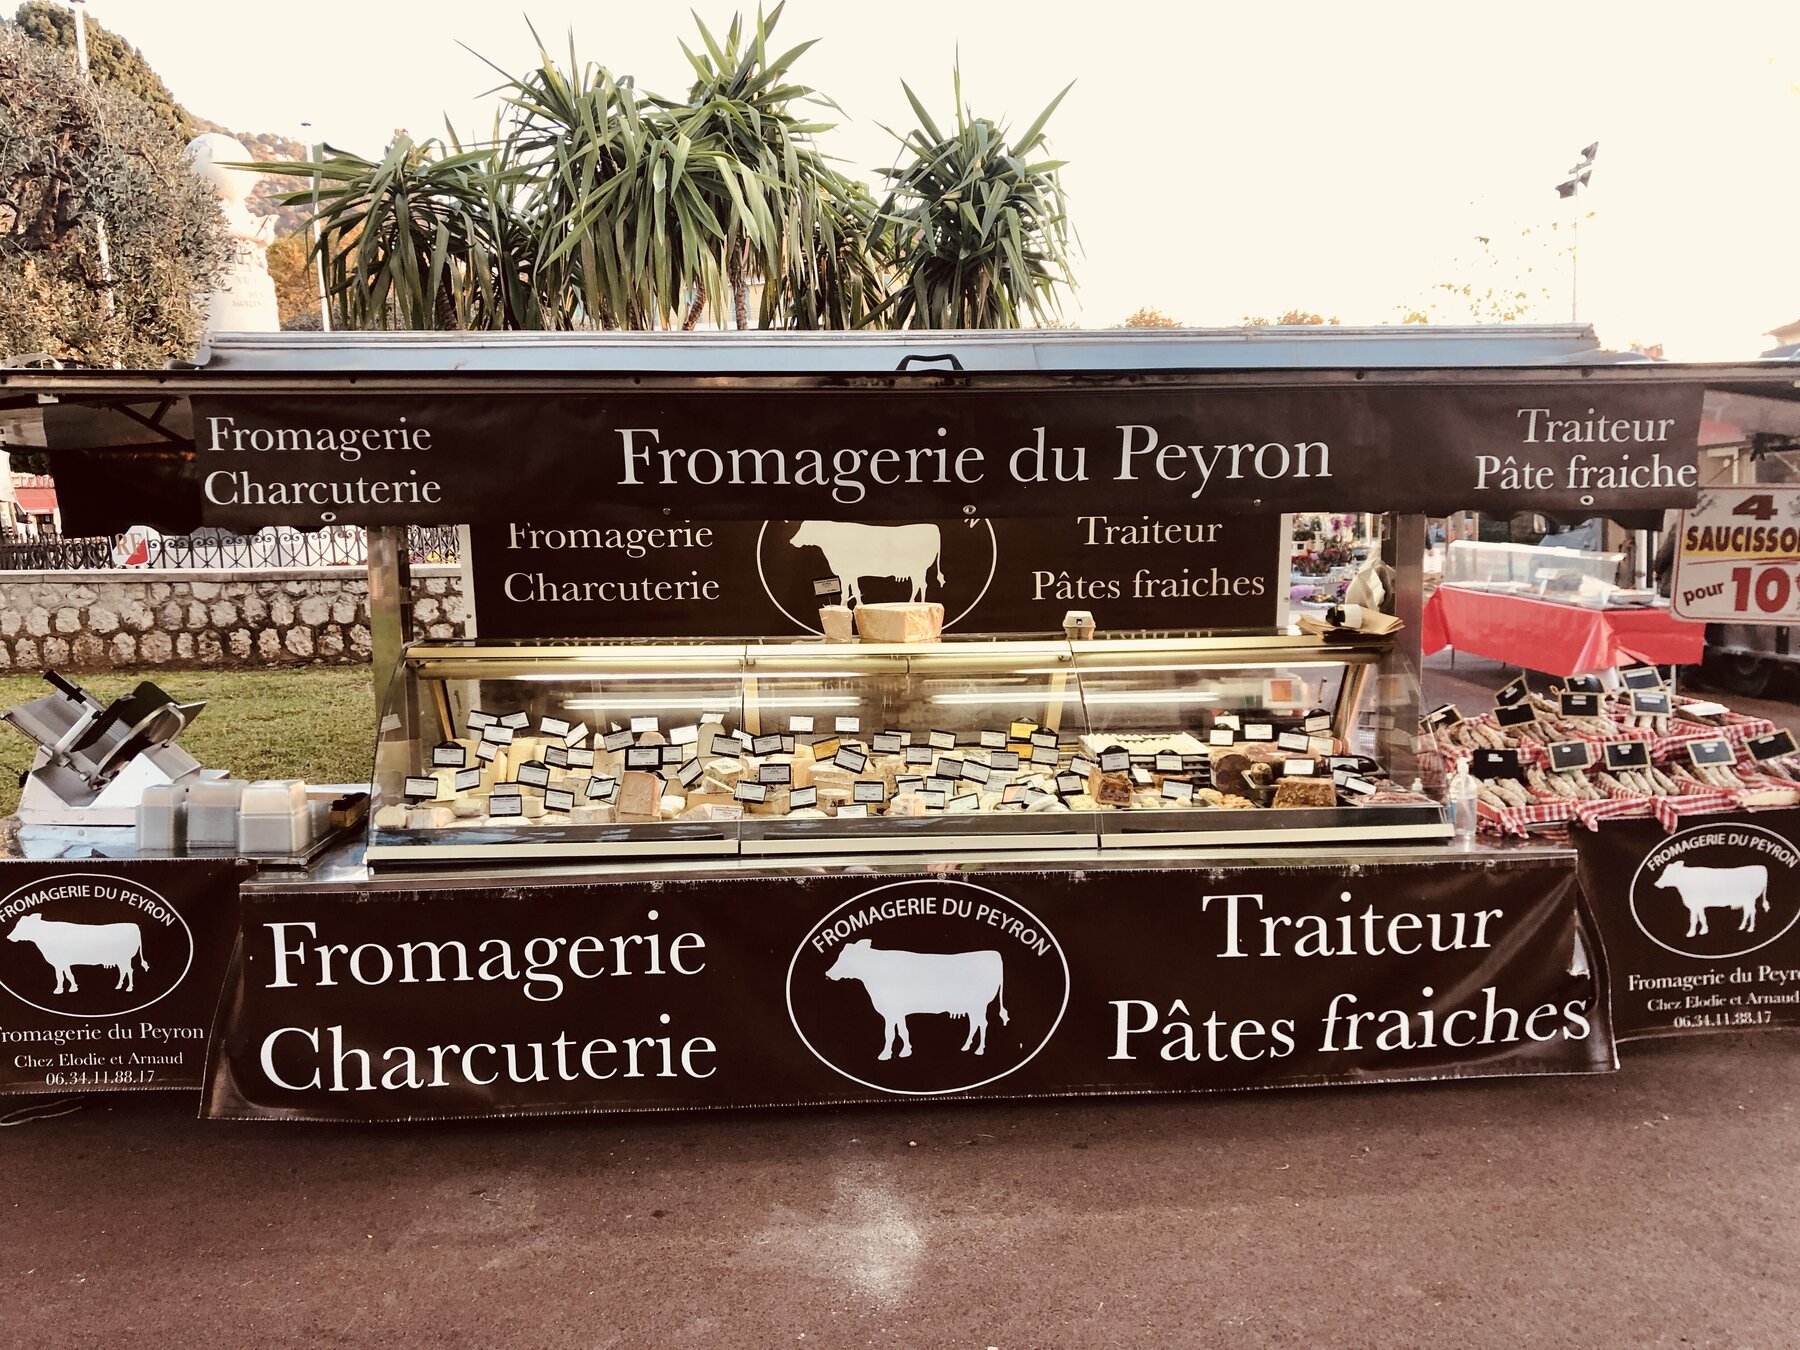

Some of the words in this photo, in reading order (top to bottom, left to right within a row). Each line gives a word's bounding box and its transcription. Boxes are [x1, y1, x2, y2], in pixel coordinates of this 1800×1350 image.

[206, 416, 433, 462] Fromagerie
[1516, 407, 1676, 444] Traiteur
[613, 427, 985, 504] Fromagerie
[1008, 426, 1090, 483] du
[1112, 424, 1334, 499] Peyron
[1473, 455, 1555, 490] Pâte
[1566, 453, 1698, 490] fraiche
[203, 469, 442, 506] Charcuterie
[1731, 494, 1779, 521] 4
[506, 519, 714, 559] Fromagerie
[1076, 515, 1224, 546] Traiteur
[1685, 525, 1800, 553] SAUCISSO
[503, 570, 720, 602] Charcuterie
[1031, 570, 1121, 600] Pâtes
[1132, 567, 1265, 599] fraiches
[1682, 582, 1725, 607] pour
[1646, 833, 1726, 872] FROMAGERIE
[1727, 833, 1749, 847] DU
[1749, 836, 1799, 869] PEYRON
[0, 885, 91, 923] FROMAGERIE
[94, 885, 118, 900] DU
[119, 889, 176, 927] PEYRON
[811, 897, 938, 954] FROMAGERIE
[941, 898, 973, 918] DU
[975, 903, 1052, 957] PEYRON
[1201, 891, 1504, 959] Traiteur
[262, 909, 707, 1002] Fromagerie
[1628, 968, 1726, 992] Fromagerie
[1729, 966, 1752, 984] du
[1757, 964, 1800, 987] Peyr
[1647, 999, 1682, 1012] Chez
[1685, 994, 1727, 1010] Elodie
[1729, 995, 1742, 1006] et
[1745, 990, 1800, 1005] Arnaud
[0, 1024, 102, 1046] romagerie
[107, 1023, 133, 1040] du
[140, 1022, 204, 1044] Peyron
[1107, 999, 1295, 1063] Pâtes
[1317, 986, 1592, 1053] fraiches
[14, 1054, 54, 1069] Chez
[59, 1052, 105, 1067] Elodie
[110, 1054, 125, 1066] et
[128, 1050, 184, 1066] Arnaud
[259, 1013, 718, 1092] Charcuterie
[45, 1070, 155, 1087] 06.34.11.88.17
